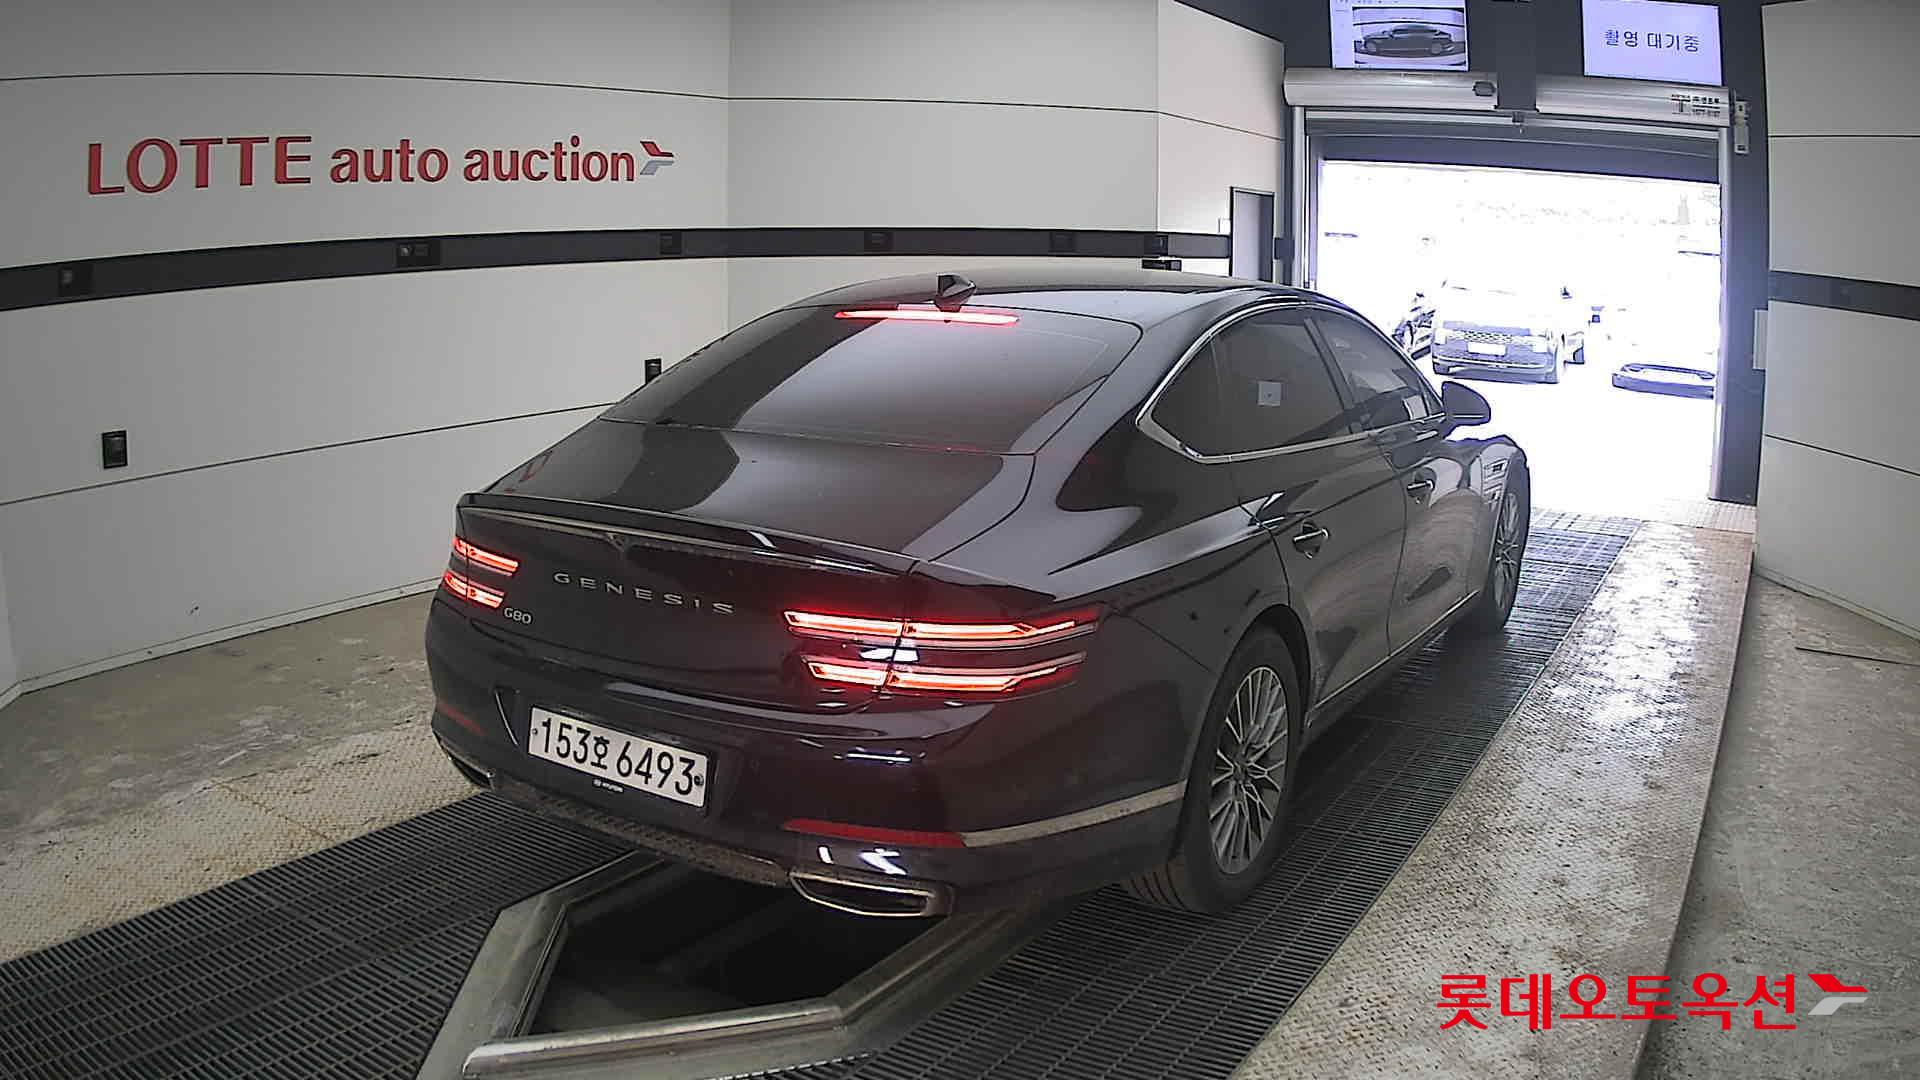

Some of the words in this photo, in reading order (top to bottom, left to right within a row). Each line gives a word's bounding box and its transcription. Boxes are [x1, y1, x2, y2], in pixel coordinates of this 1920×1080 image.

[1604, 30, 1638, 48] 촬영
[1647, 33, 1699, 52] 대기중
[87, 135, 313, 196] LOTTE
[328, 138, 449, 184] auto
[462, 134, 636, 183] auction
[553, 571, 734, 615] GENESIS
[503, 606, 533, 625] G80
